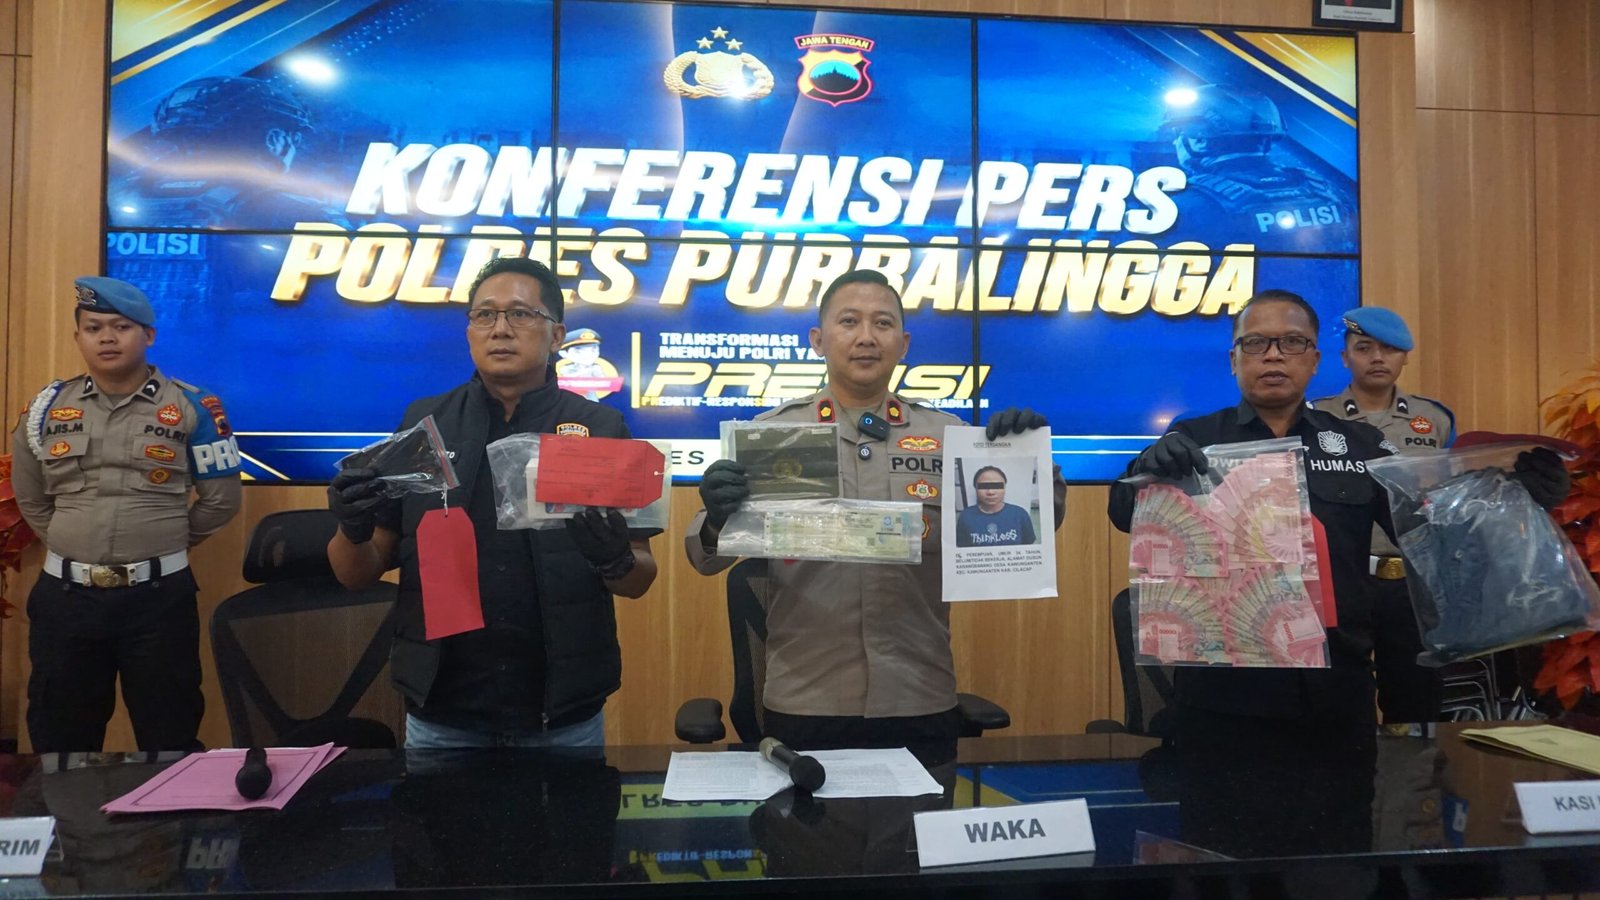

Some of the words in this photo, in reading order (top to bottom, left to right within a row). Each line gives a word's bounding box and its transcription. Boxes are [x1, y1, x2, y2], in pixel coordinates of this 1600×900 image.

[800, 36, 828, 46] JAWA
[345, 141, 944, 229] KONFERENSI
[955, 160, 1187, 235] PERS
[1255, 205, 1341, 233] POLISI
[270, 222, 648, 306] POLRES
[659, 229, 1255, 317] PURBALINGGA
[659, 332, 799, 347] TRANSFORMASI
[659, 345, 735, 359] MENUJU
[739, 347, 791, 360] POLRI
[794, 347, 826, 360] YA
[643, 361, 991, 399] PREISI
[144, 424, 186, 441] POLRI
[892, 456, 943, 474] POLR
[1310, 459, 1366, 474] HUMAS
[1553, 795, 1596, 811] KASI
[964, 818, 1046, 843] WAKA
[0, 838, 41, 856] RIM
